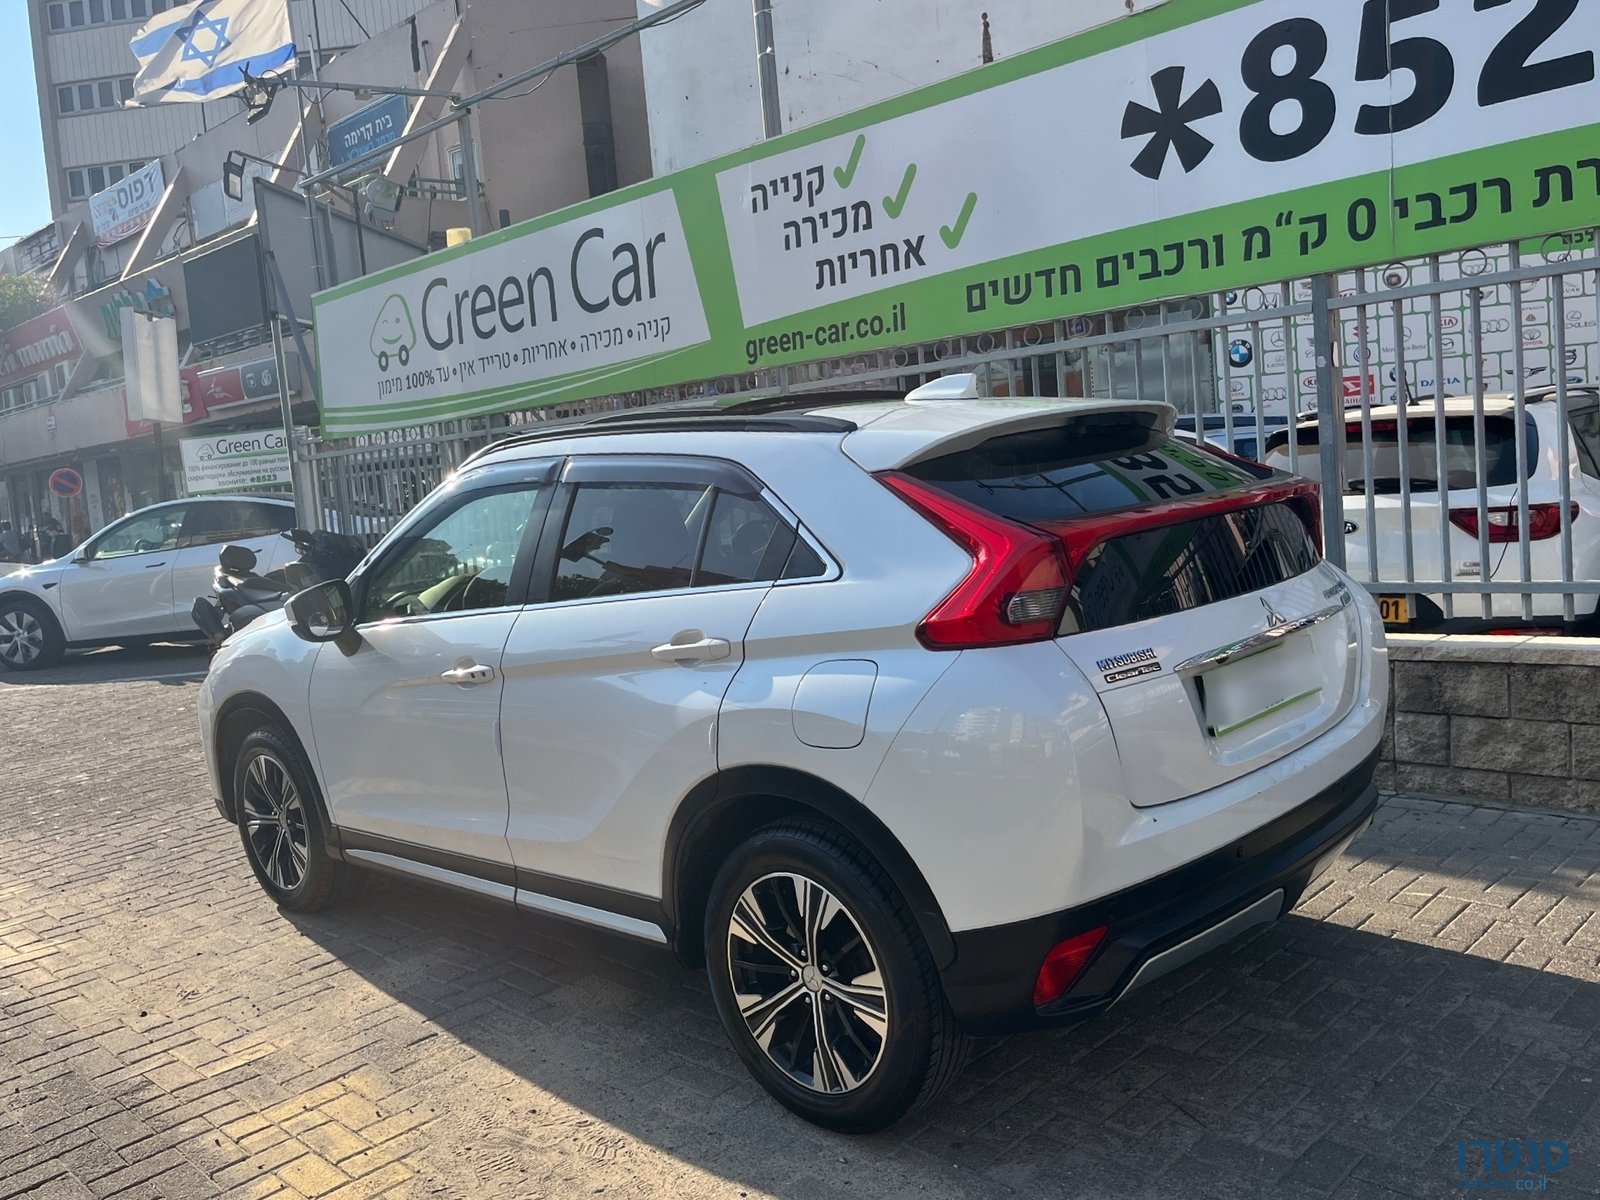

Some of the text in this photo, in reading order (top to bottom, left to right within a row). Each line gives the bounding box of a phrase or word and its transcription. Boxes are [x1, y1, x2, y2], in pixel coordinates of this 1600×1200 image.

[375, 114, 393, 134] בית
[117, 172, 154, 209] דפוס
[751, 164, 825, 214] קנייה
[1393, 177, 1512, 231] רכבי
[783, 200, 873, 251] מכירה
[1347, 197, 1377, 242] 0
[815, 234, 926, 290] אחריות
[1096, 233, 1225, 289] ורכבים
[421, 227, 666, 351] Green Car
[966, 263, 1082, 314] חדשים
[377, 316, 671, 400] קניה מכירה אחריות טרייד אין עד 100% מימון
[745, 302, 906, 365] green-car.co.il
[1420, 377, 1461, 388] DAIA
[216, 439, 261, 454] Green
[1381, 600, 1400, 621] 01
[1096, 647, 1157, 672] MITSUBISHI
[1105, 663, 1161, 682] ClearTec
